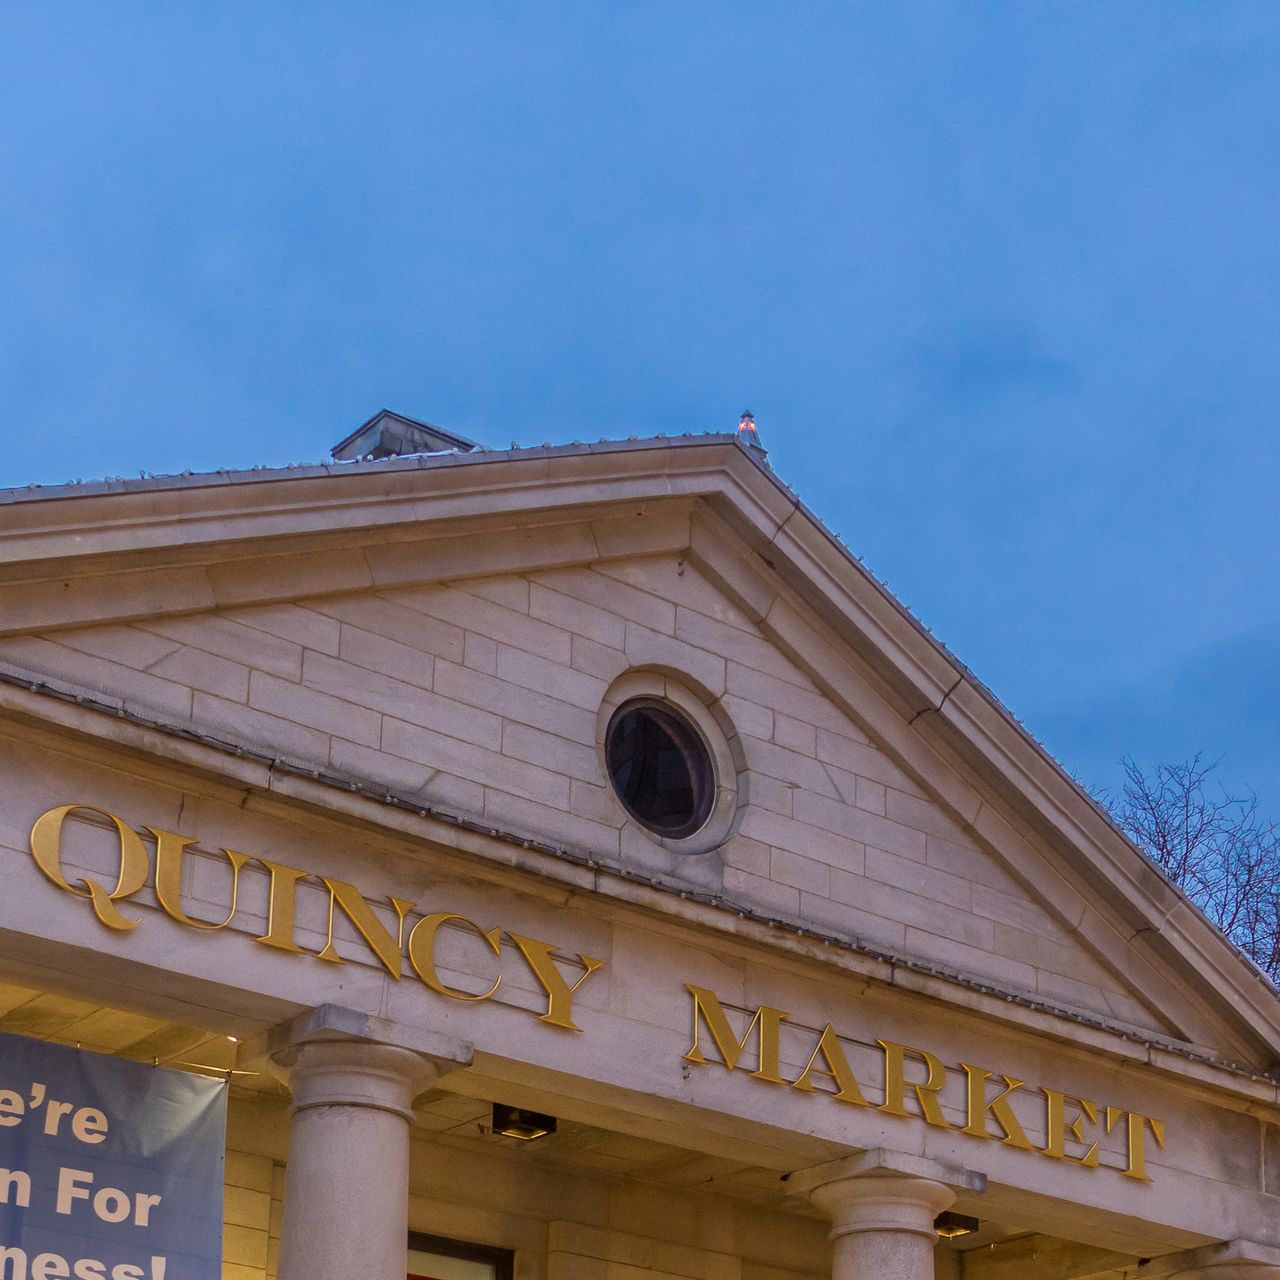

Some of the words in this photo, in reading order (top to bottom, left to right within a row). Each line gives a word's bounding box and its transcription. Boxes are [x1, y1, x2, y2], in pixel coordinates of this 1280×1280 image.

[30, 804, 604, 1032] QUINCY
[682, 983, 1166, 1182] MARKET
[55, 1166, 162, 1228] For
